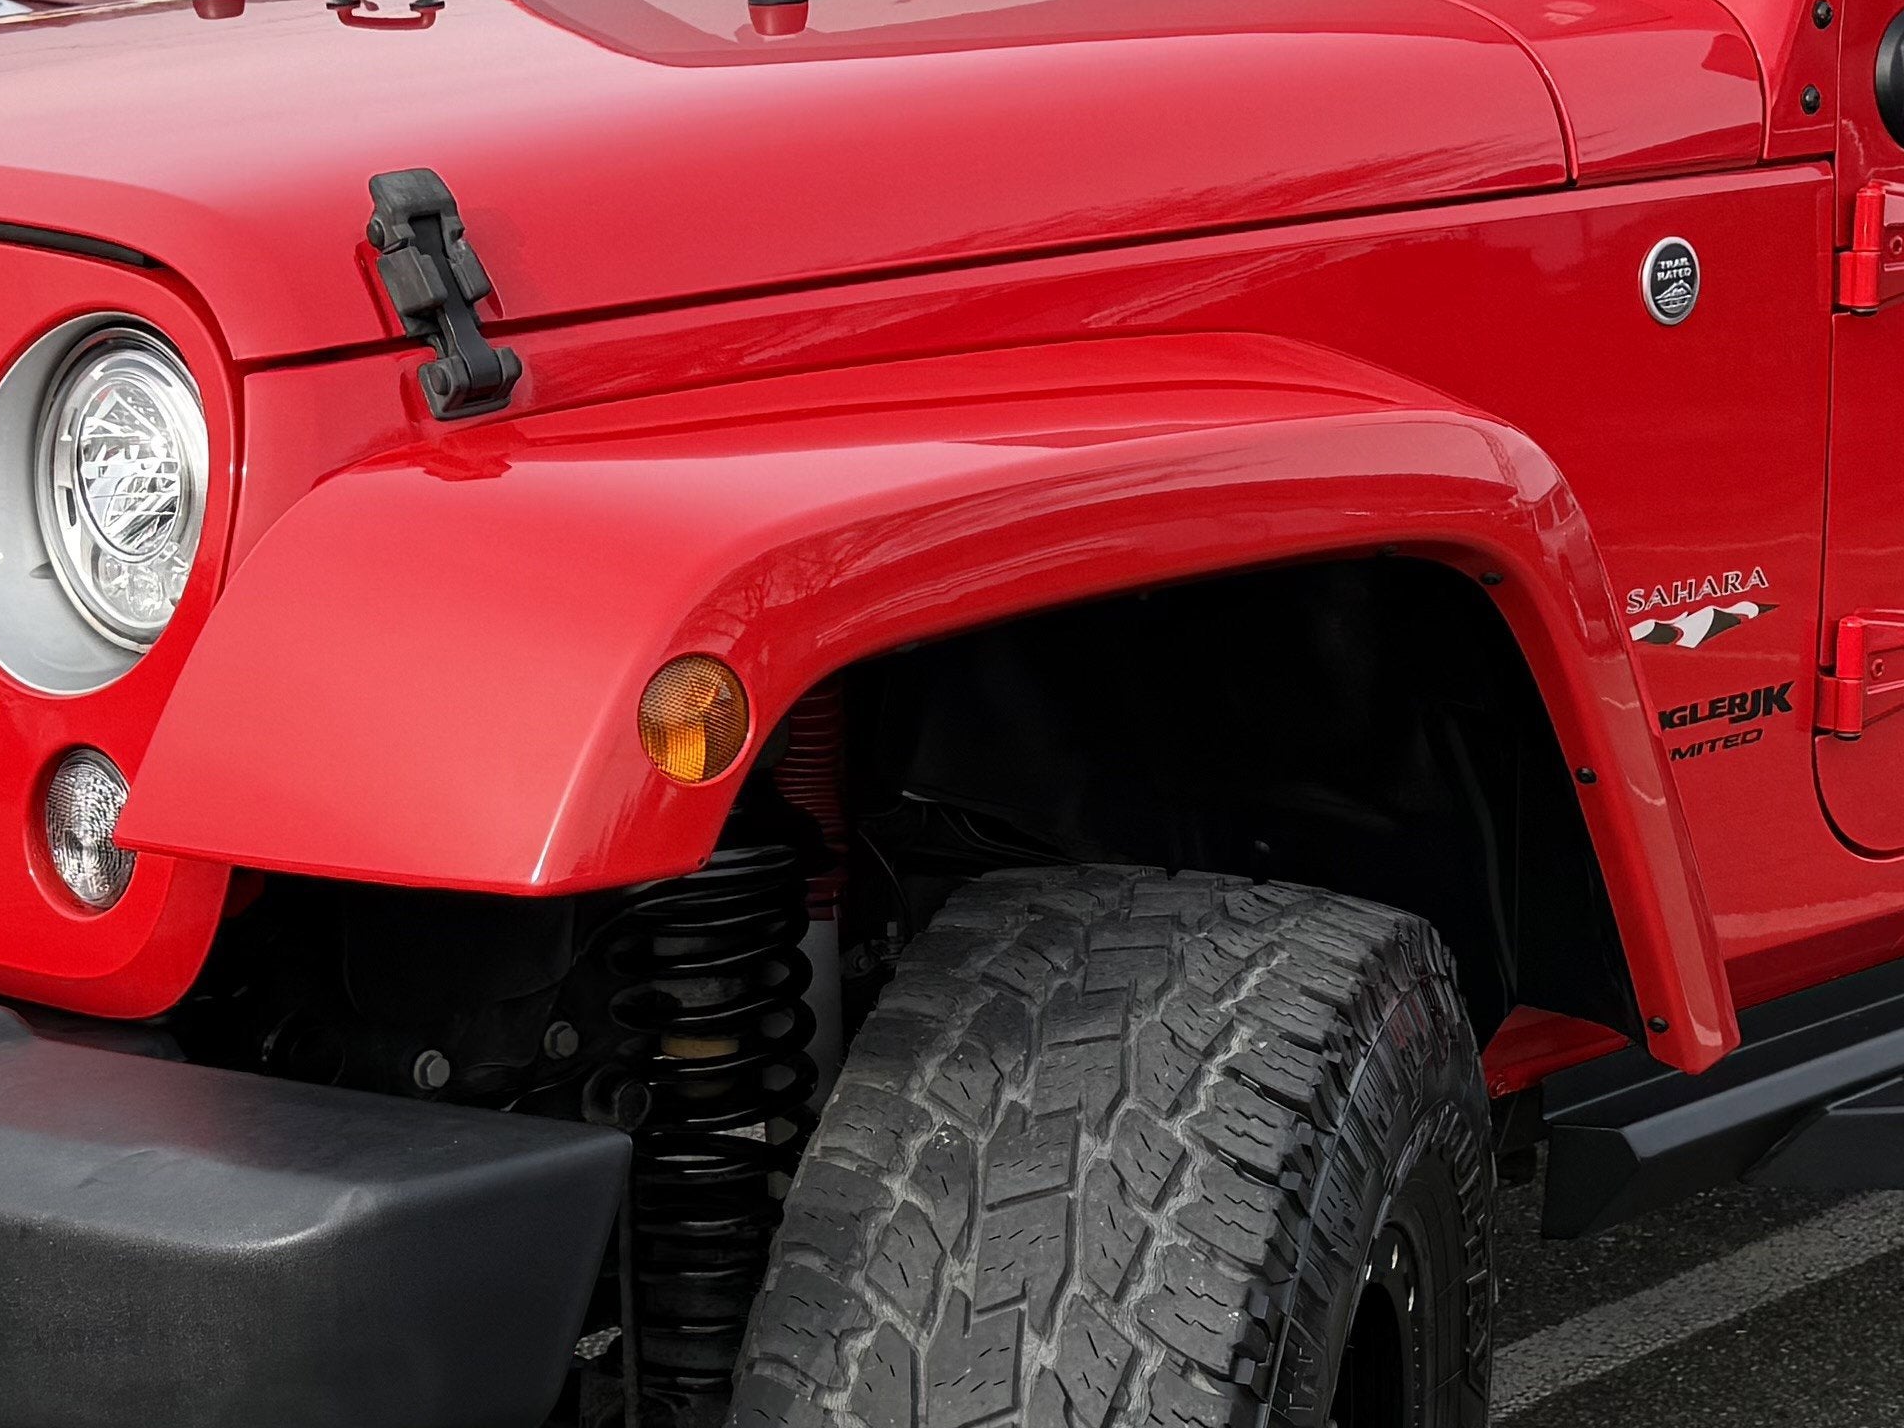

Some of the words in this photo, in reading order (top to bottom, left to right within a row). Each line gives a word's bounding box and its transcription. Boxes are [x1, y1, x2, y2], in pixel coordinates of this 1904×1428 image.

[1657, 268, 1692, 282] RATED
[1625, 566, 1769, 614] SAHARA
[1669, 728, 1763, 761] MITED
